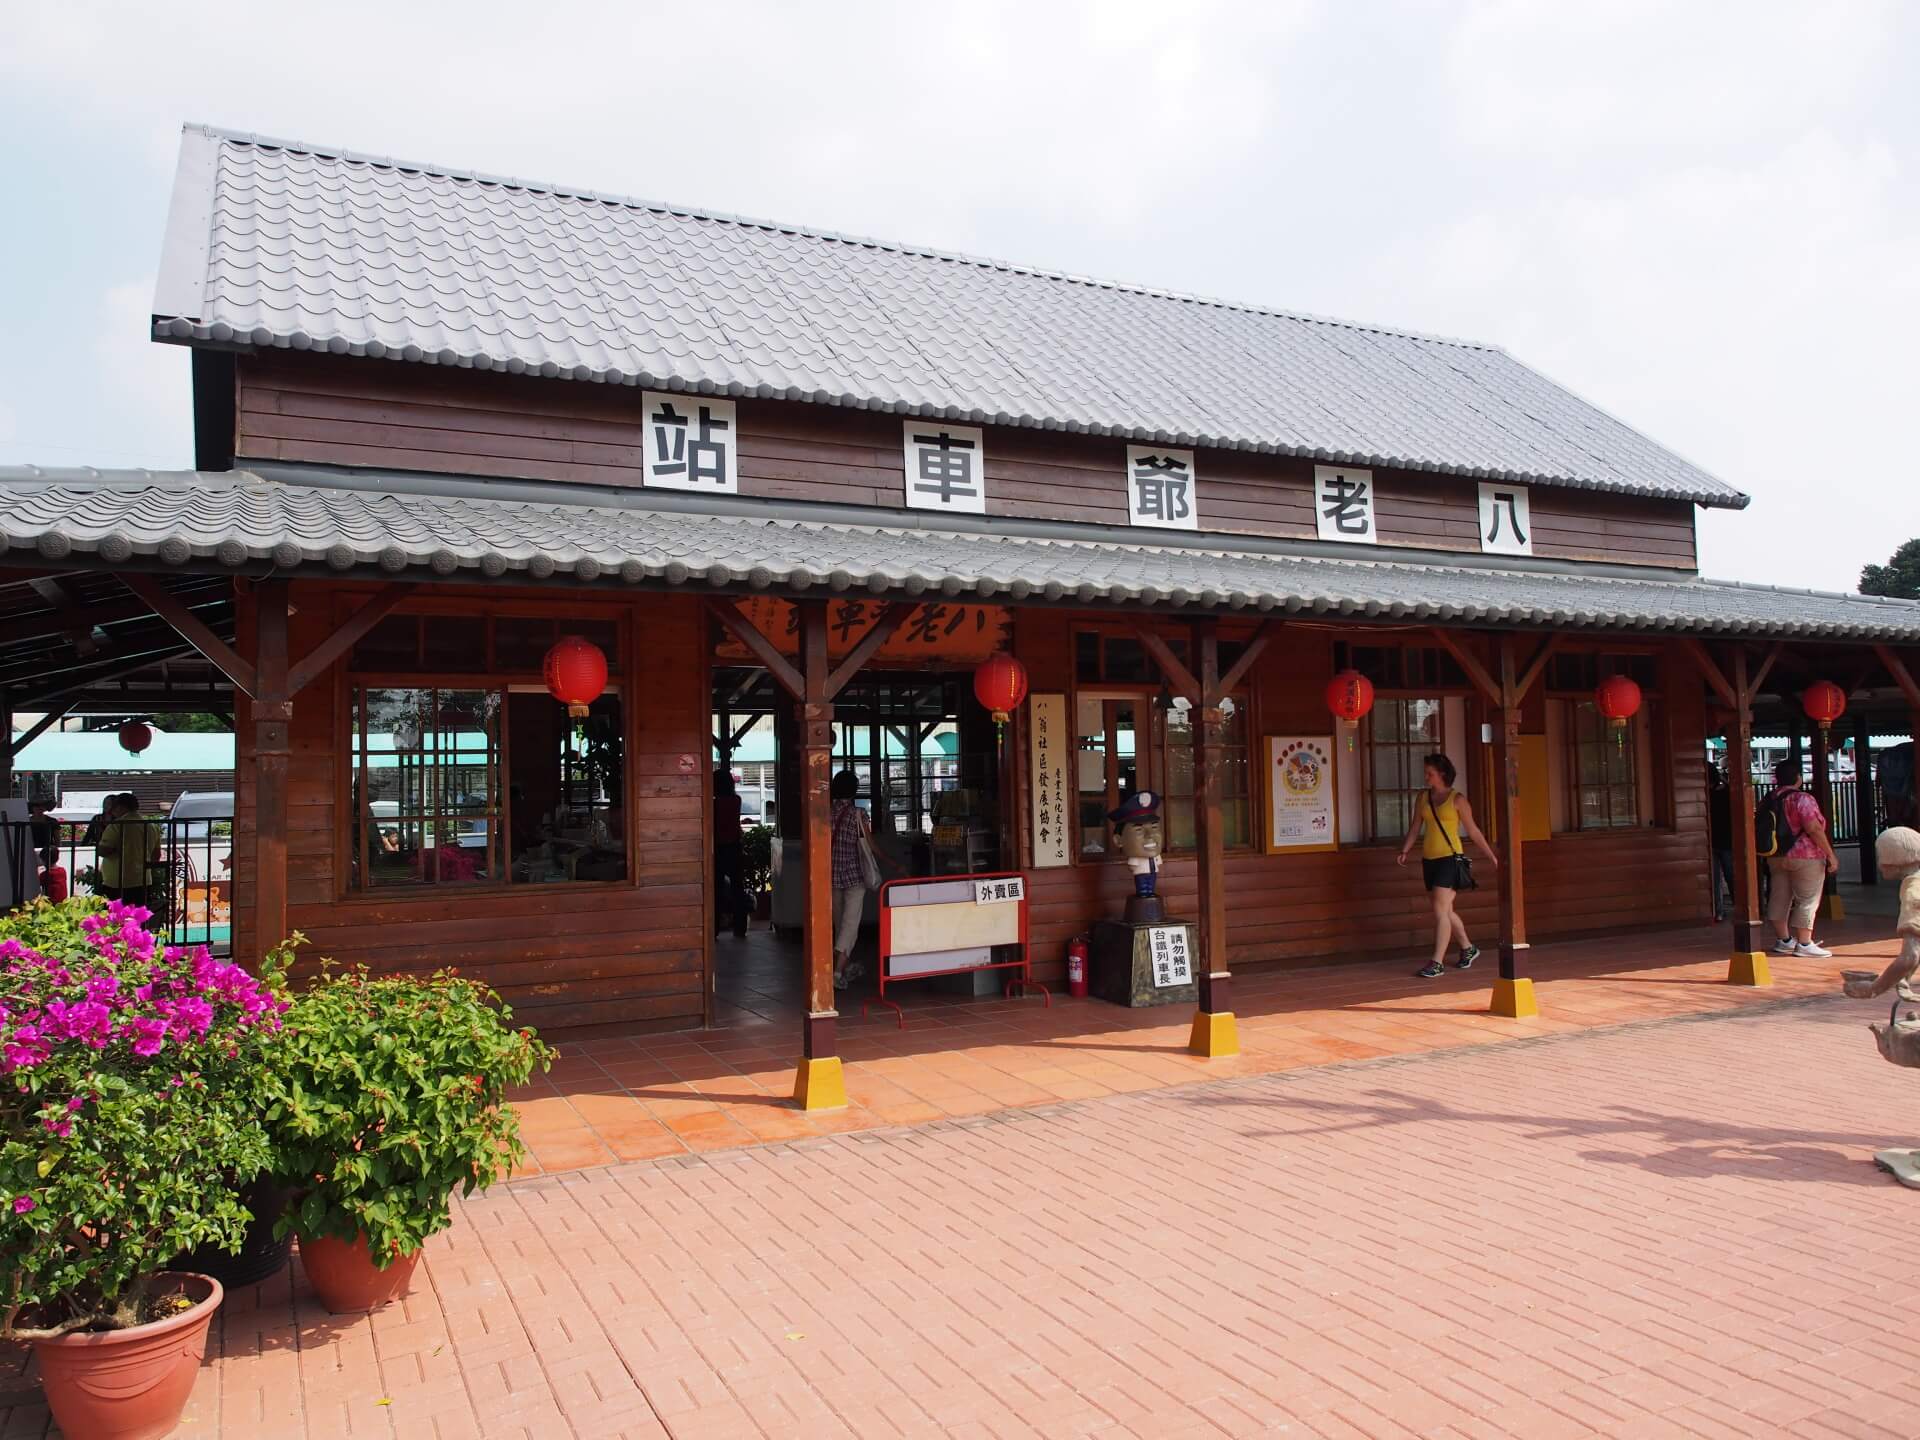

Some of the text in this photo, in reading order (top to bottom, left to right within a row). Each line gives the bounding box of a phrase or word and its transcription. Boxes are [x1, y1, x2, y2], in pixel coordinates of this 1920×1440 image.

[651, 401, 1529, 545] 八 老 爺 車 站
[980, 882, 1020, 901] 外賣區
[1171, 933, 1187, 977] 請勿觸摸
